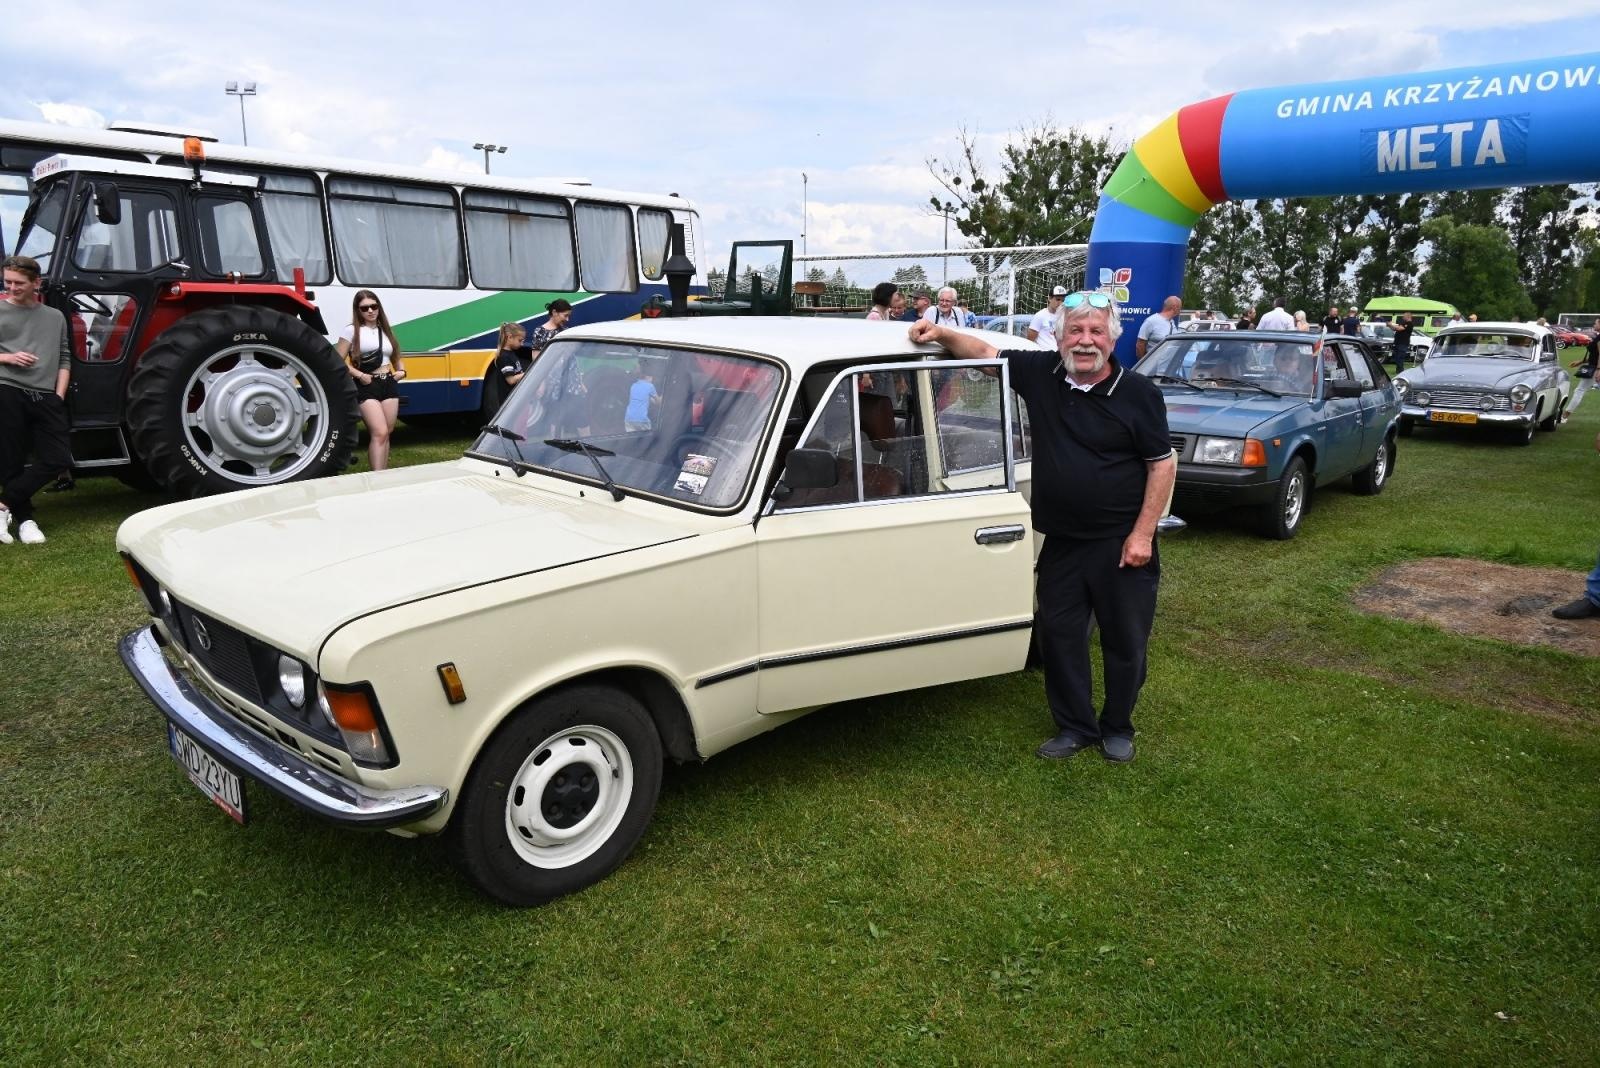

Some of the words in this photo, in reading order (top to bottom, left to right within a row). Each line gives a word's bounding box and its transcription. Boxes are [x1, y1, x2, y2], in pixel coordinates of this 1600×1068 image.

[1276, 91, 1374, 119] GMINA
[1383, 65, 1600, 108] KRZYŻANOW
[1377, 118, 1507, 173] META
[1431, 412, 1445, 421] SB
[175, 729, 200, 774] SWD
[203, 753, 240, 809] 23YU
